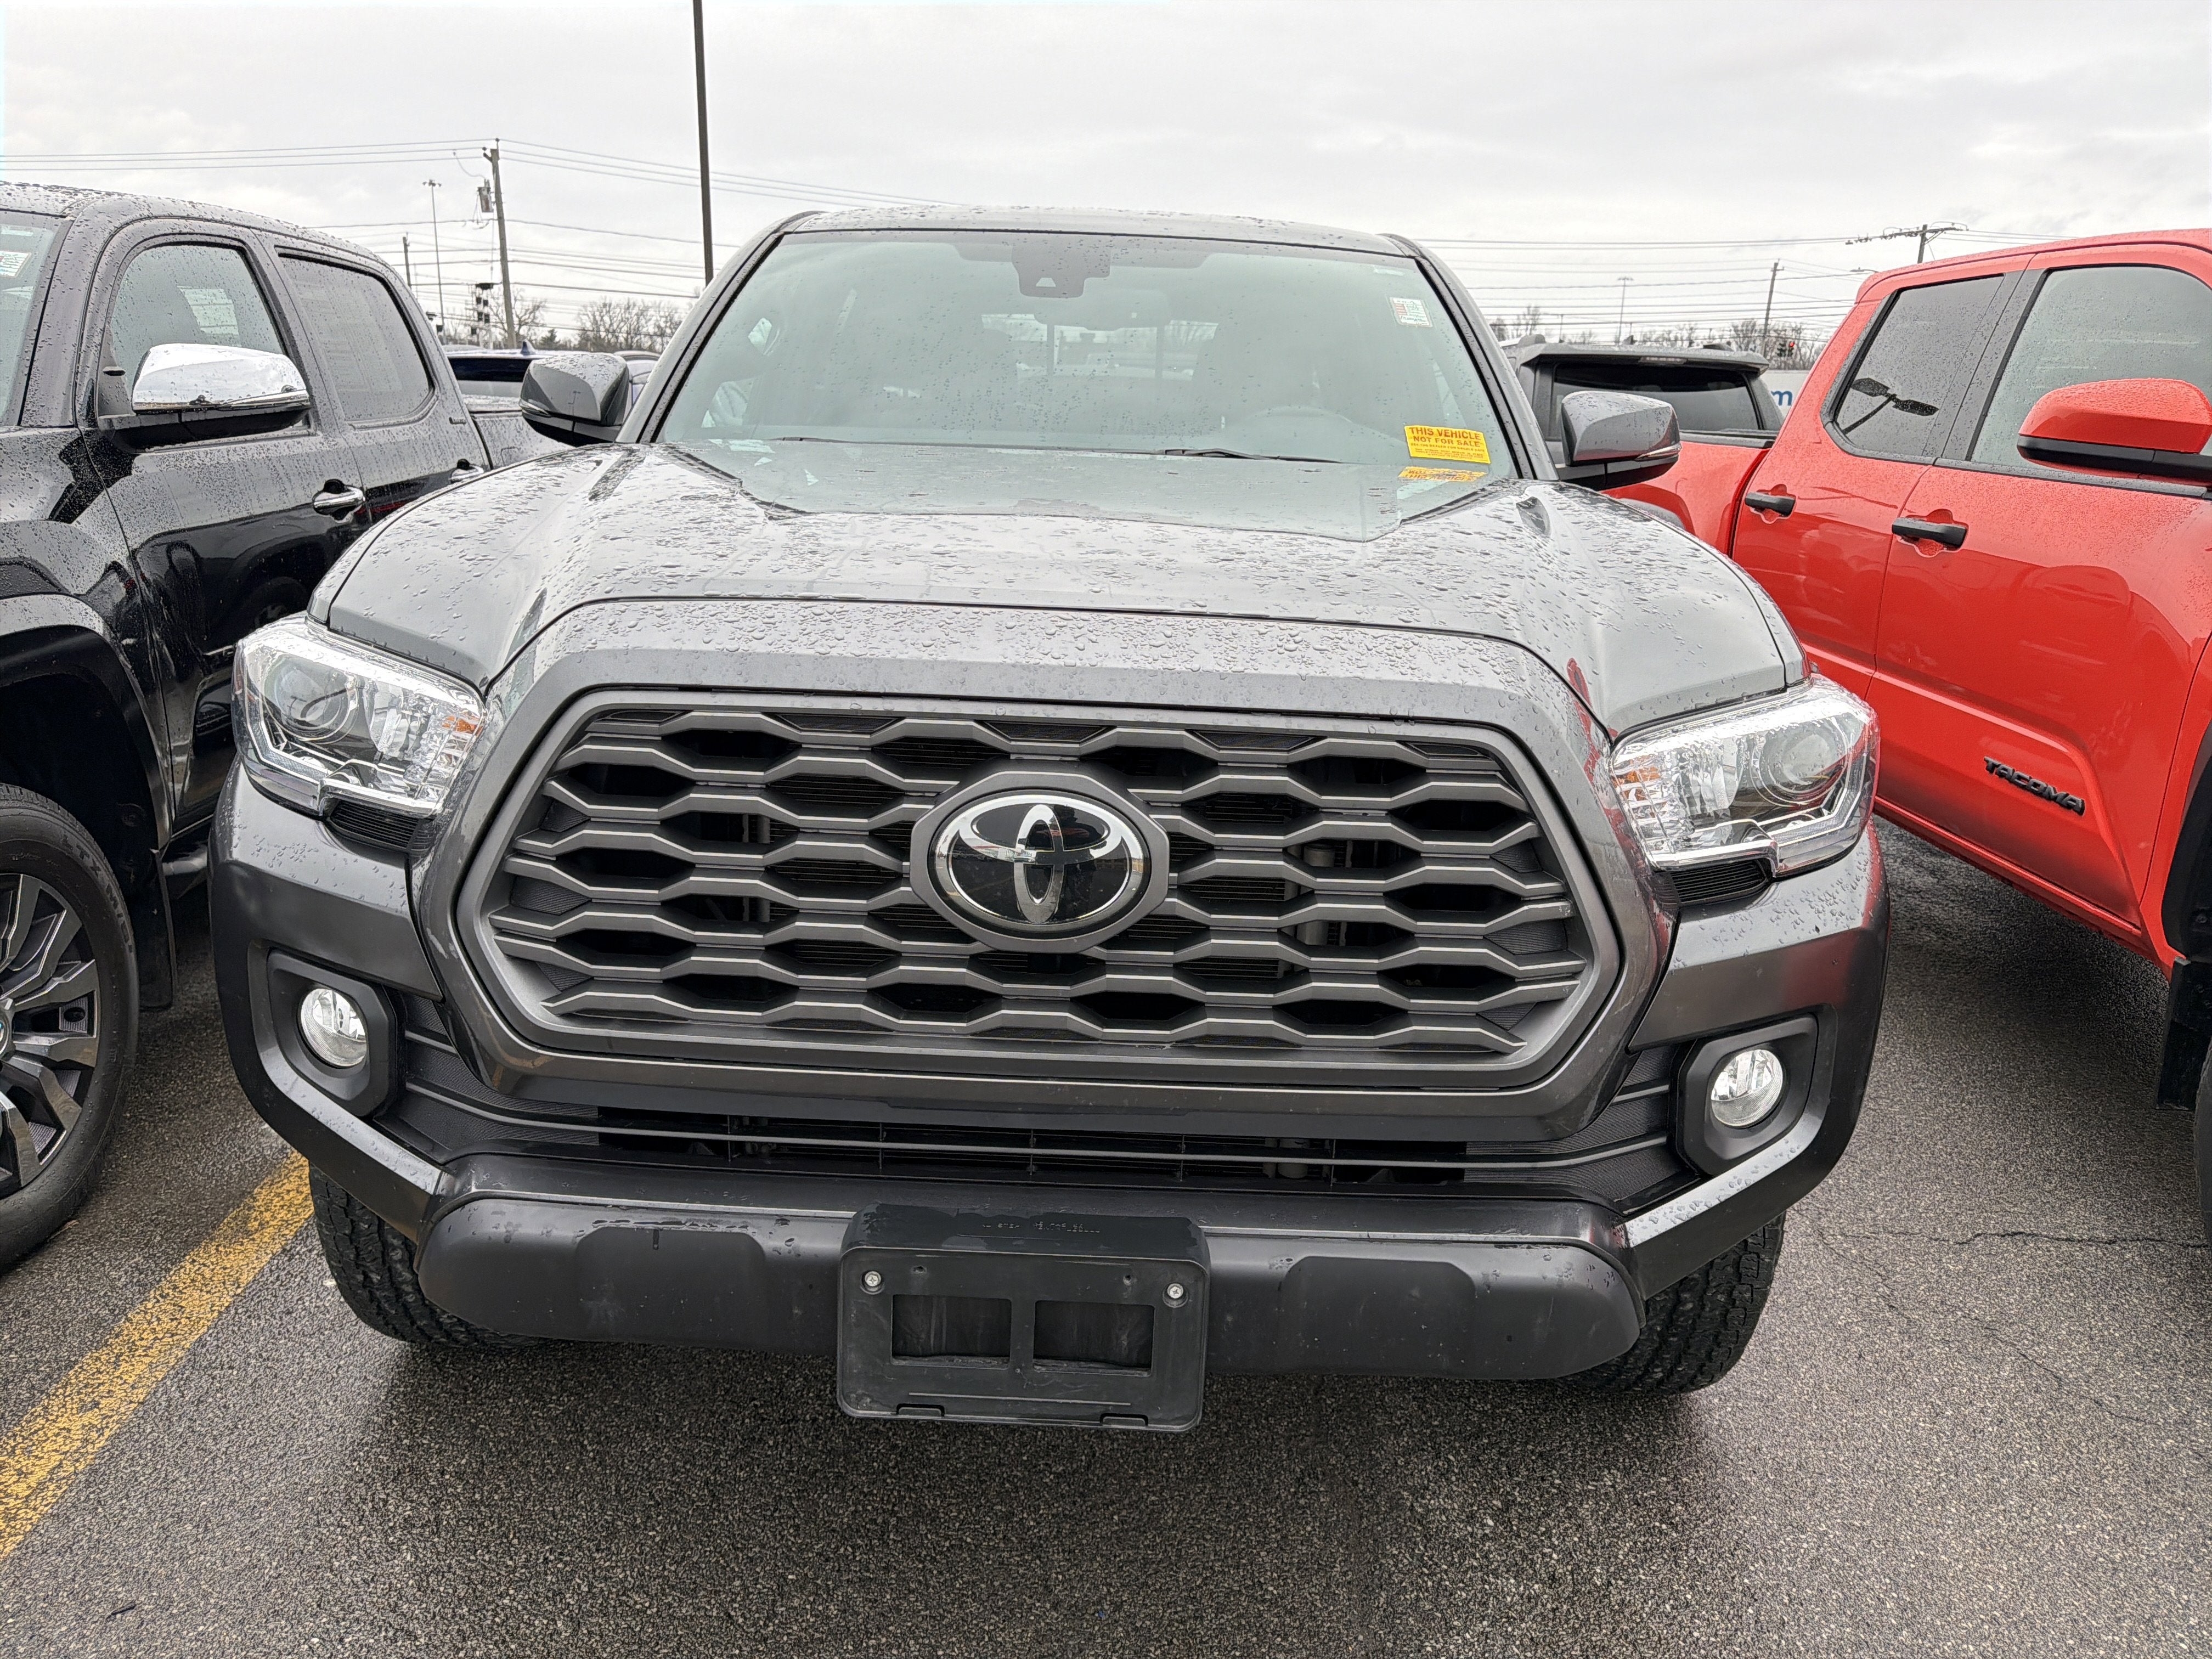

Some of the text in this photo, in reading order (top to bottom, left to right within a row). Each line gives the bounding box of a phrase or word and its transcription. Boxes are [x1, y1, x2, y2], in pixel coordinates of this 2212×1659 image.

[1409, 427, 1481, 440] THIS VEHICLE
[1983, 755, 2085, 816] TACOMA
[62, 834, 101, 878] LTX
